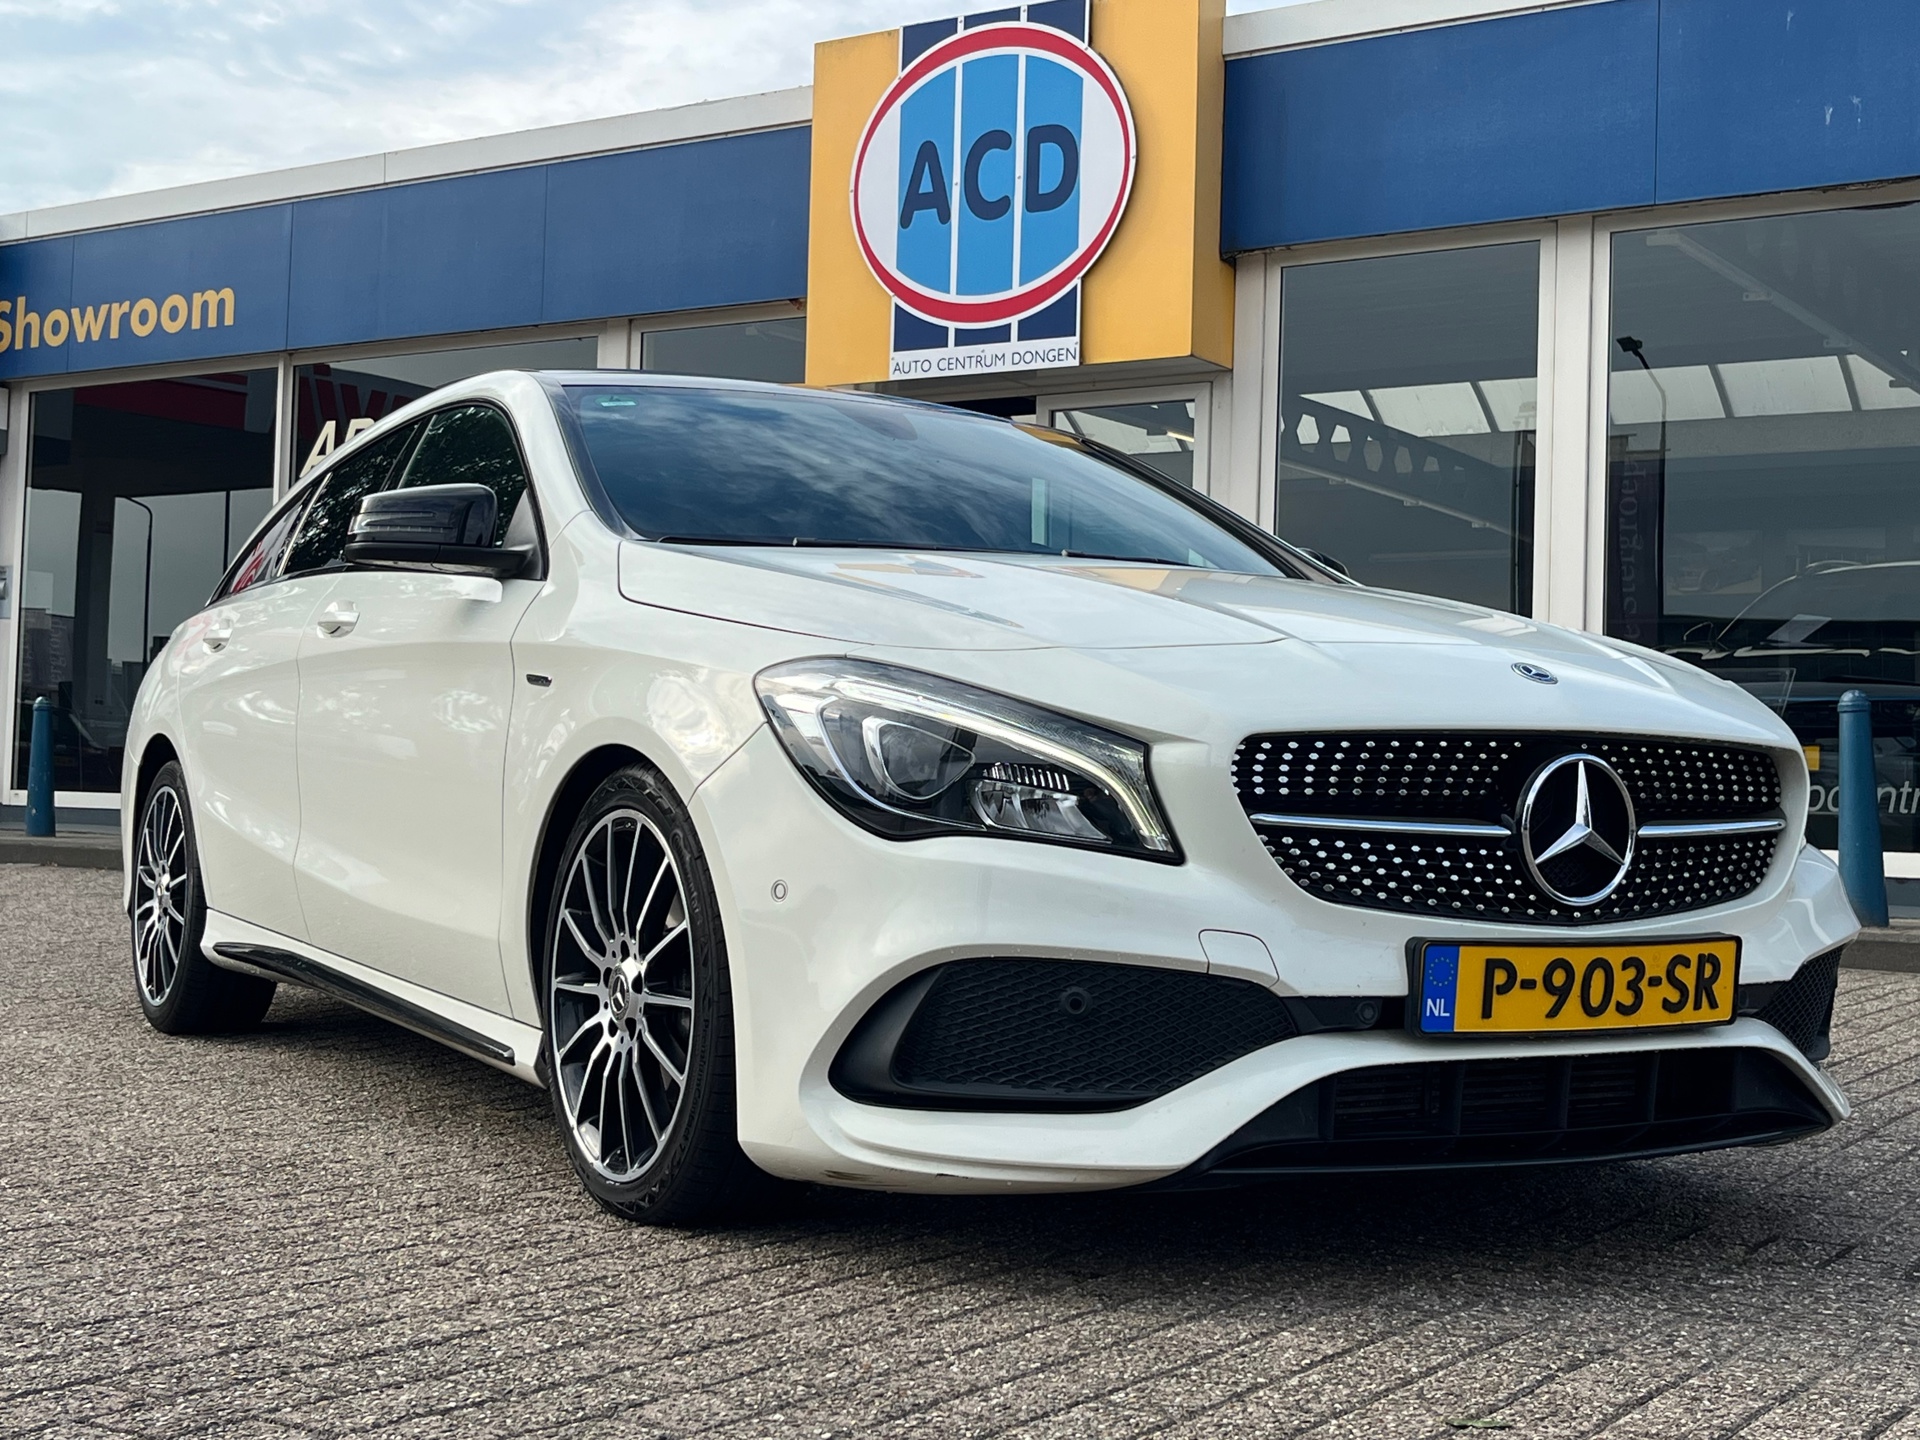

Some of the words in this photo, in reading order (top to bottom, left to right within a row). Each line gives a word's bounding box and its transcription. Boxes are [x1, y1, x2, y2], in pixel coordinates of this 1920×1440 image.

[900, 124, 1079, 229] ACD
[0, 287, 235, 354] Showroom
[892, 359, 932, 375] AUTO
[937, 353, 1006, 371] CENTRUM
[1012, 347, 1077, 366] DONGEN
[1425, 998, 1450, 1018] NL
[1481, 952, 1721, 1019] P-903-SR
